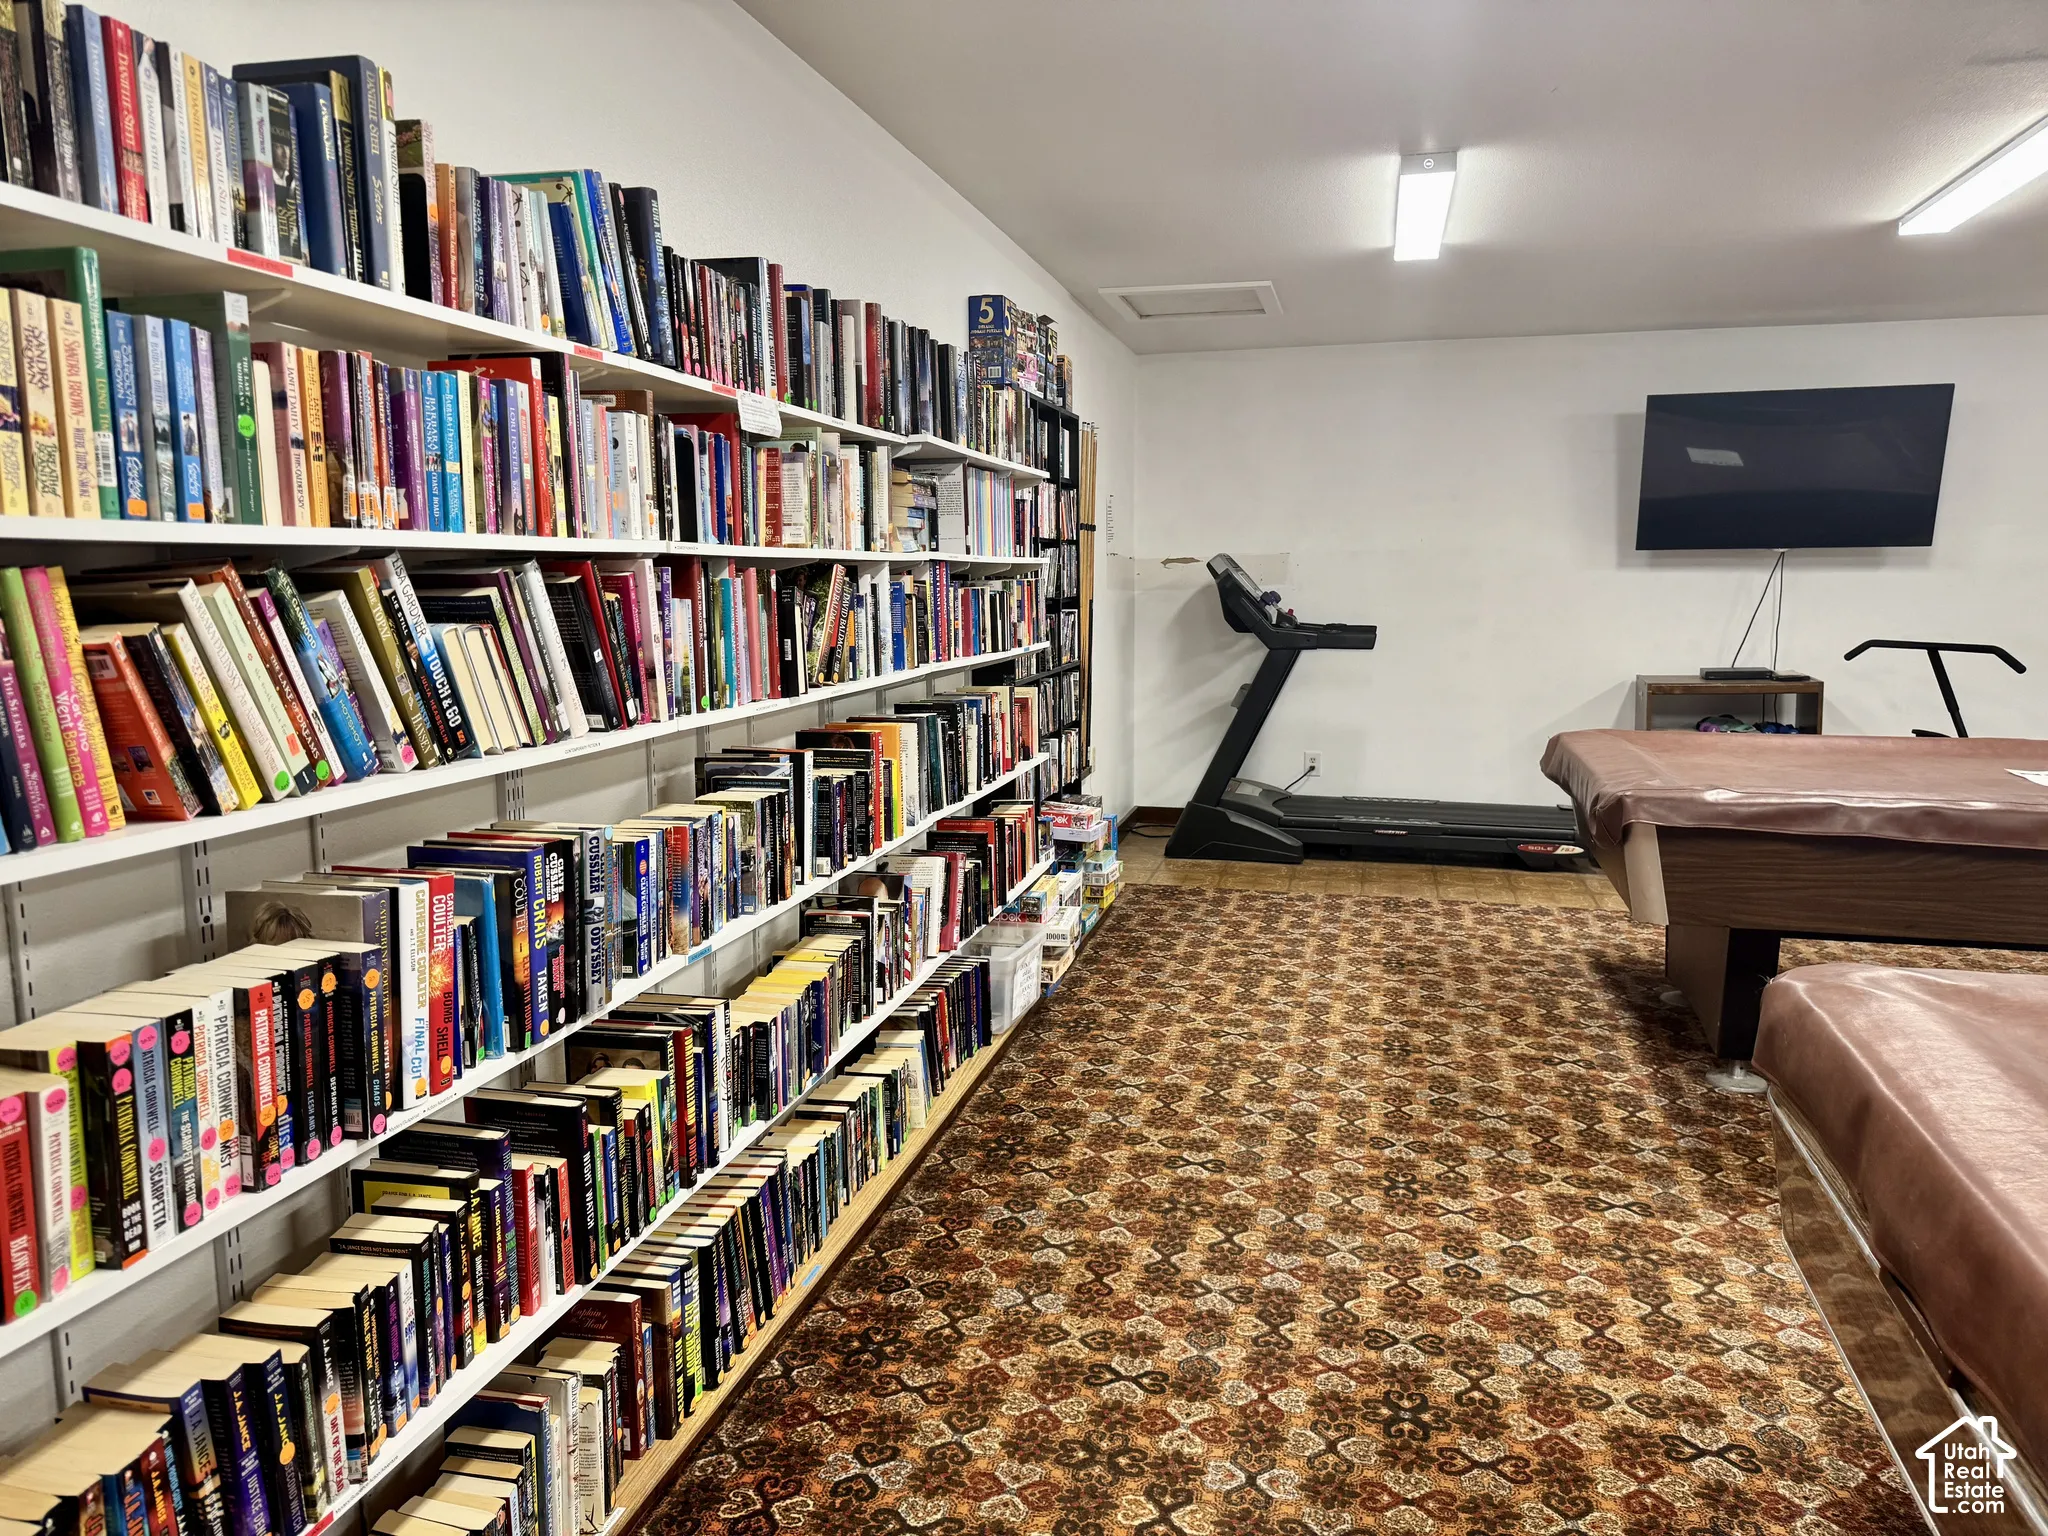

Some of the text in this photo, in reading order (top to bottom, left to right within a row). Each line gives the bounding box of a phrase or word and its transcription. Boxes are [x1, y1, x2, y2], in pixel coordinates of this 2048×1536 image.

[366, 71, 379, 155] DANIELLE STEEL
[372, 176, 383, 224] Sisters
[978, 298, 994, 324] 5
[22, 324, 37, 385] BROWN
[35, 328, 50, 394] SANDRA
[111, 349, 125, 400] BROWN
[121, 346, 134, 407] CAROLYN
[430, 397, 438, 450] BARBARA
[536, 405, 544, 447] WEDDING
[431, 472, 440, 496] COAST
[230, 569, 269, 647] KIM EDWARDS
[279, 569, 317, 649] JULIE GARWOOD
[391, 559, 427, 638] LISA GARDNER
[391, 595, 409, 636] LIE STILL
[537, 578, 564, 655] JAN KARON
[827, 568, 845, 634] DAVID BALDACCI
[835, 593, 850, 659] DAVID BALDACCI
[191, 657, 216, 702] STICKS
[426, 651, 462, 728] TOUCH & GO
[270, 653, 280, 673] THE
[278, 673, 295, 701] LAKE
[297, 715, 319, 760] DREAMS
[339, 698, 363, 747] HOTSHOT
[420, 675, 449, 743] JULIA HEABERLIN
[55, 690, 86, 788] Went Bananas
[411, 713, 432, 754] HANSEN
[229, 741, 254, 792] DIANE MOTT
[535, 855, 544, 895] ROBERT
[549, 852, 559, 903] CUSSLER
[589, 836, 600, 894] CUSSLER
[432, 895, 447, 952] COULTER
[446, 892, 454, 949] CATHERINE
[513, 878, 525, 935] COULTER
[533, 898, 547, 950] CRAIS
[415, 889, 427, 1010] CATHERINE COULTER
[590, 927, 601, 985] ODYSSEY
[1046, 933, 1061, 941] 1000
[443, 991, 452, 1024] BOMB
[537, 967, 548, 1013] TAKEN
[194, 1024, 207, 1067] PATRICIA
[255, 1009, 269, 1055] PATRICIA
[369, 991, 381, 1107] PATRICIA CORNWELL CHAOS
[414, 1017, 425, 1055] FINAL
[436, 1027, 449, 1061] SHELL
[170, 1056, 185, 1110] CORNWELL
[181, 1056, 196, 1101] PATRICIA
[214, 1015, 234, 1123] PATRICIA CORNWE
[304, 1013, 316, 1132] PATRICIA CORNWELL FLESH AND
[326, 1001, 338, 1116] PATRICIA CORNWELL DEPRAVED
[667, 1040, 676, 1098] KELLERMAN
[196, 1070, 210, 1121] CORNWELL
[684, 1034, 697, 1168] JONATHAN KELLERMAN BONES
[116, 1095, 139, 1200] PATRICIA CORNWELL
[219, 1140, 231, 1169] MIST
[268, 1135, 279, 1161] BONE
[278, 1114, 293, 1148] dust
[48, 1132, 64, 1226] PATRICIA CORNWELL
[180, 1110, 197, 1206] THE SCARPETTA FACTO
[582, 1151, 593, 1187] NIGHT
[3, 1140, 27, 1235] PATRICIA CORNWELL
[149, 1163, 167, 1231] SCARPETTA
[502, 1151, 514, 1223] IRIS JOHANSEN
[585, 1189, 595, 1229] WATCH
[460, 1246, 468, 1276] JANCE
[469, 1188, 486, 1321] J.A. JANCE DANCE OF THE BONE
[563, 1239, 574, 1287] JOHANSEN
[362, 1305, 372, 1333] TRIAL
[364, 1335, 372, 1346] BY
[463, 1300, 473, 1330] FIRE
[364, 1346, 374, 1370] FURY
[464, 1334, 473, 1355] ICE
[686, 1333, 696, 1377] SHADOW
[273, 1393, 285, 1416] J.A.
[322, 1338, 345, 1493] J.A. JANCE DAY OF THE DEAD
[368, 1399, 377, 1431] JANCE
[193, 1430, 211, 1474] JANCE
[232, 1390, 261, 1510] J.A. JANCE JUSTICE
[277, 1416, 290, 1445] JANC
[164, 1445, 182, 1512] UNTIL PROVEN GUILTY
[289, 1499, 303, 1530] WATCH
